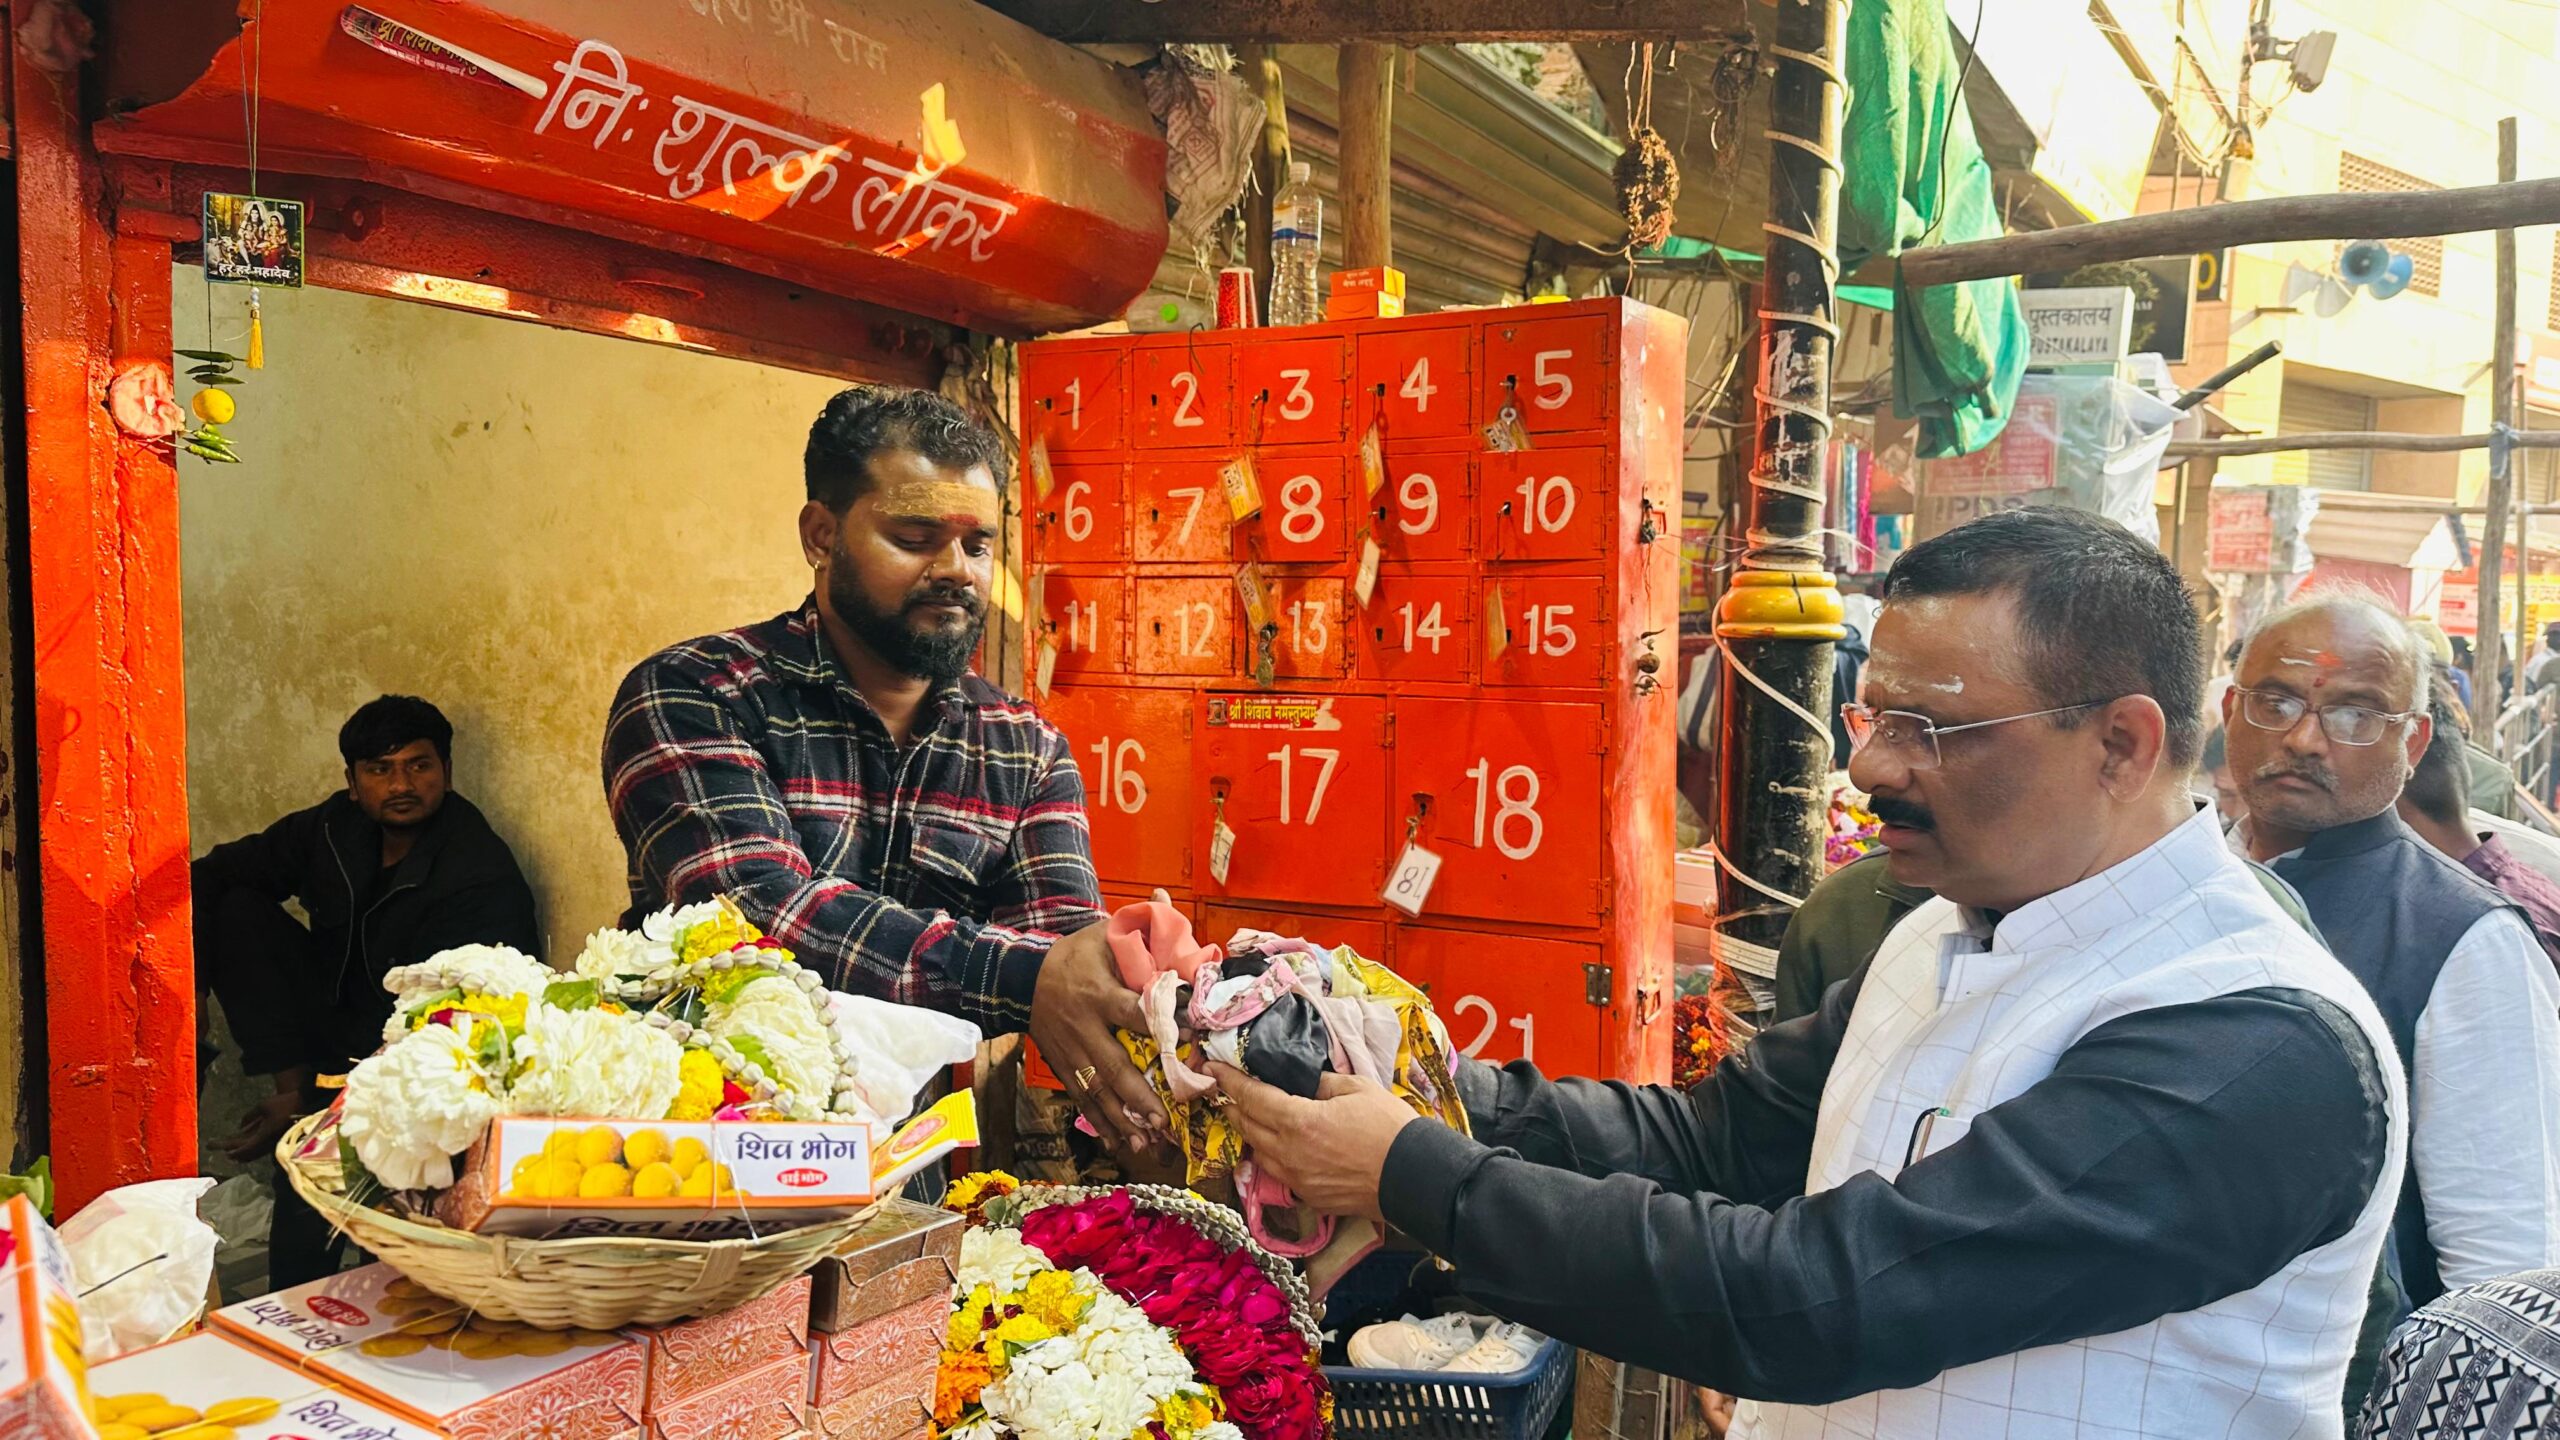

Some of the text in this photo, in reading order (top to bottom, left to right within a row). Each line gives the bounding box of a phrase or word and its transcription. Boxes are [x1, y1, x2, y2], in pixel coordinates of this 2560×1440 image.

[823, 18, 888, 75] राम
[652, 94, 853, 208] शुल्क
[252, 265, 291, 279] महादेव
[2029, 307, 2112, 333] पुस्तकालय
[1065, 376, 1080, 430] 1
[1171, 372, 1204, 427] 2
[1279, 369, 1314, 420] 3
[1399, 357, 1436, 412] 4
[1534, 349, 1573, 409] 5
[1064, 481, 1093, 541] 6
[1168, 487, 1204, 545] 7
[1280, 475, 1325, 543] 8
[1399, 473, 1438, 535] 9
[1516, 476, 1576, 534] 10
[1064, 600, 1098, 653] 11
[1173, 601, 1215, 657] 12
[1287, 601, 1327, 654] 13
[1399, 601, 1450, 654] 14
[1523, 604, 1577, 657] 15
[1229, 698, 1241, 720] श्री
[1244, 699, 1272, 720] शिवाय
[1091, 736, 1147, 814] 16
[1267, 744, 1340, 825] 17
[1466, 756, 1543, 861] 18
[1454, 994, 1534, 1062] 21
[736, 1131, 856, 1160] शिव भोग
[288, 1400, 359, 1434] शिव
